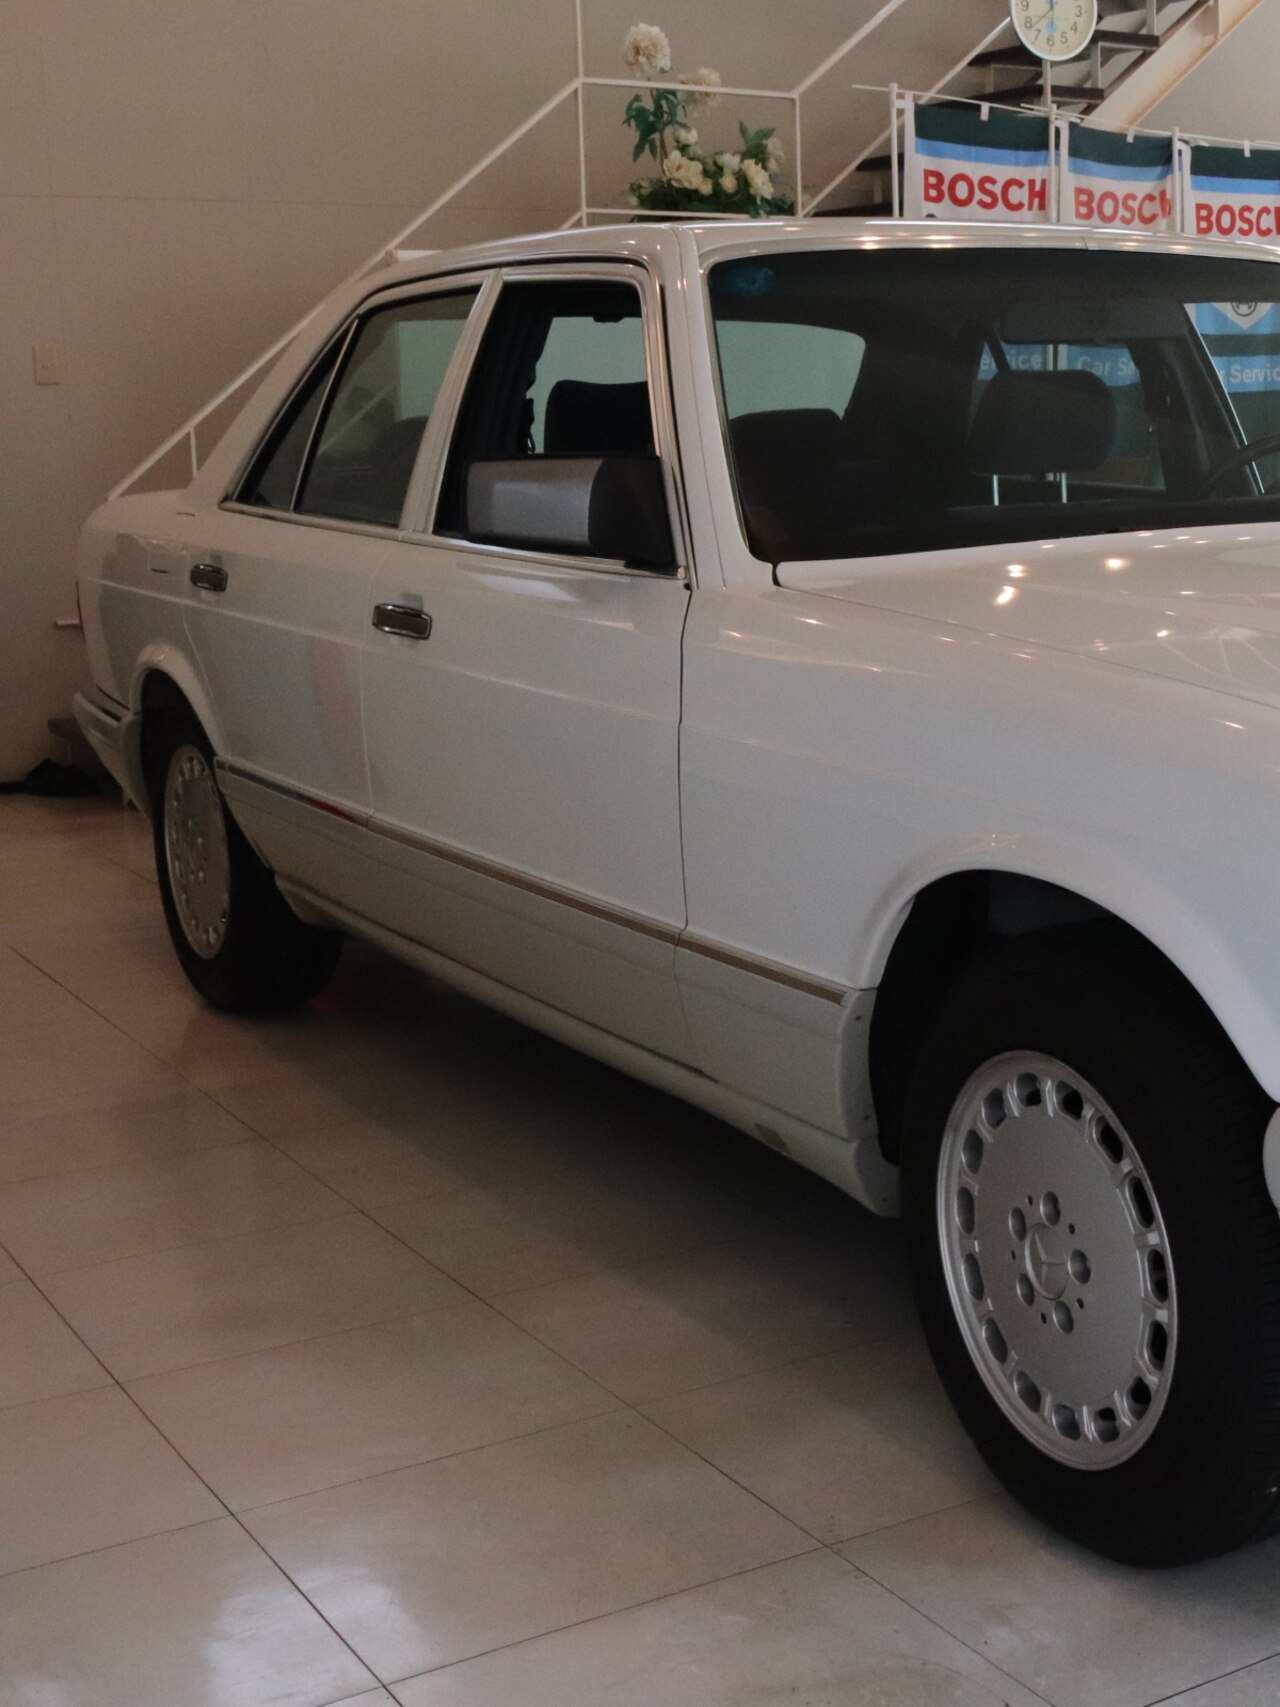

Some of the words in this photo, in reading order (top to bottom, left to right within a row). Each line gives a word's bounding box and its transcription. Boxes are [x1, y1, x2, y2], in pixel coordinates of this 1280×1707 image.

[1074, 5, 1083, 17] 3
[1024, 16, 1033, 29] 8
[1070, 22, 1078, 33] 4
[1034, 29, 1042, 41] 7
[1046, 34, 1055, 47] 6
[1060, 32, 1069, 44] 5
[923, 168, 1047, 211] BOSCH
